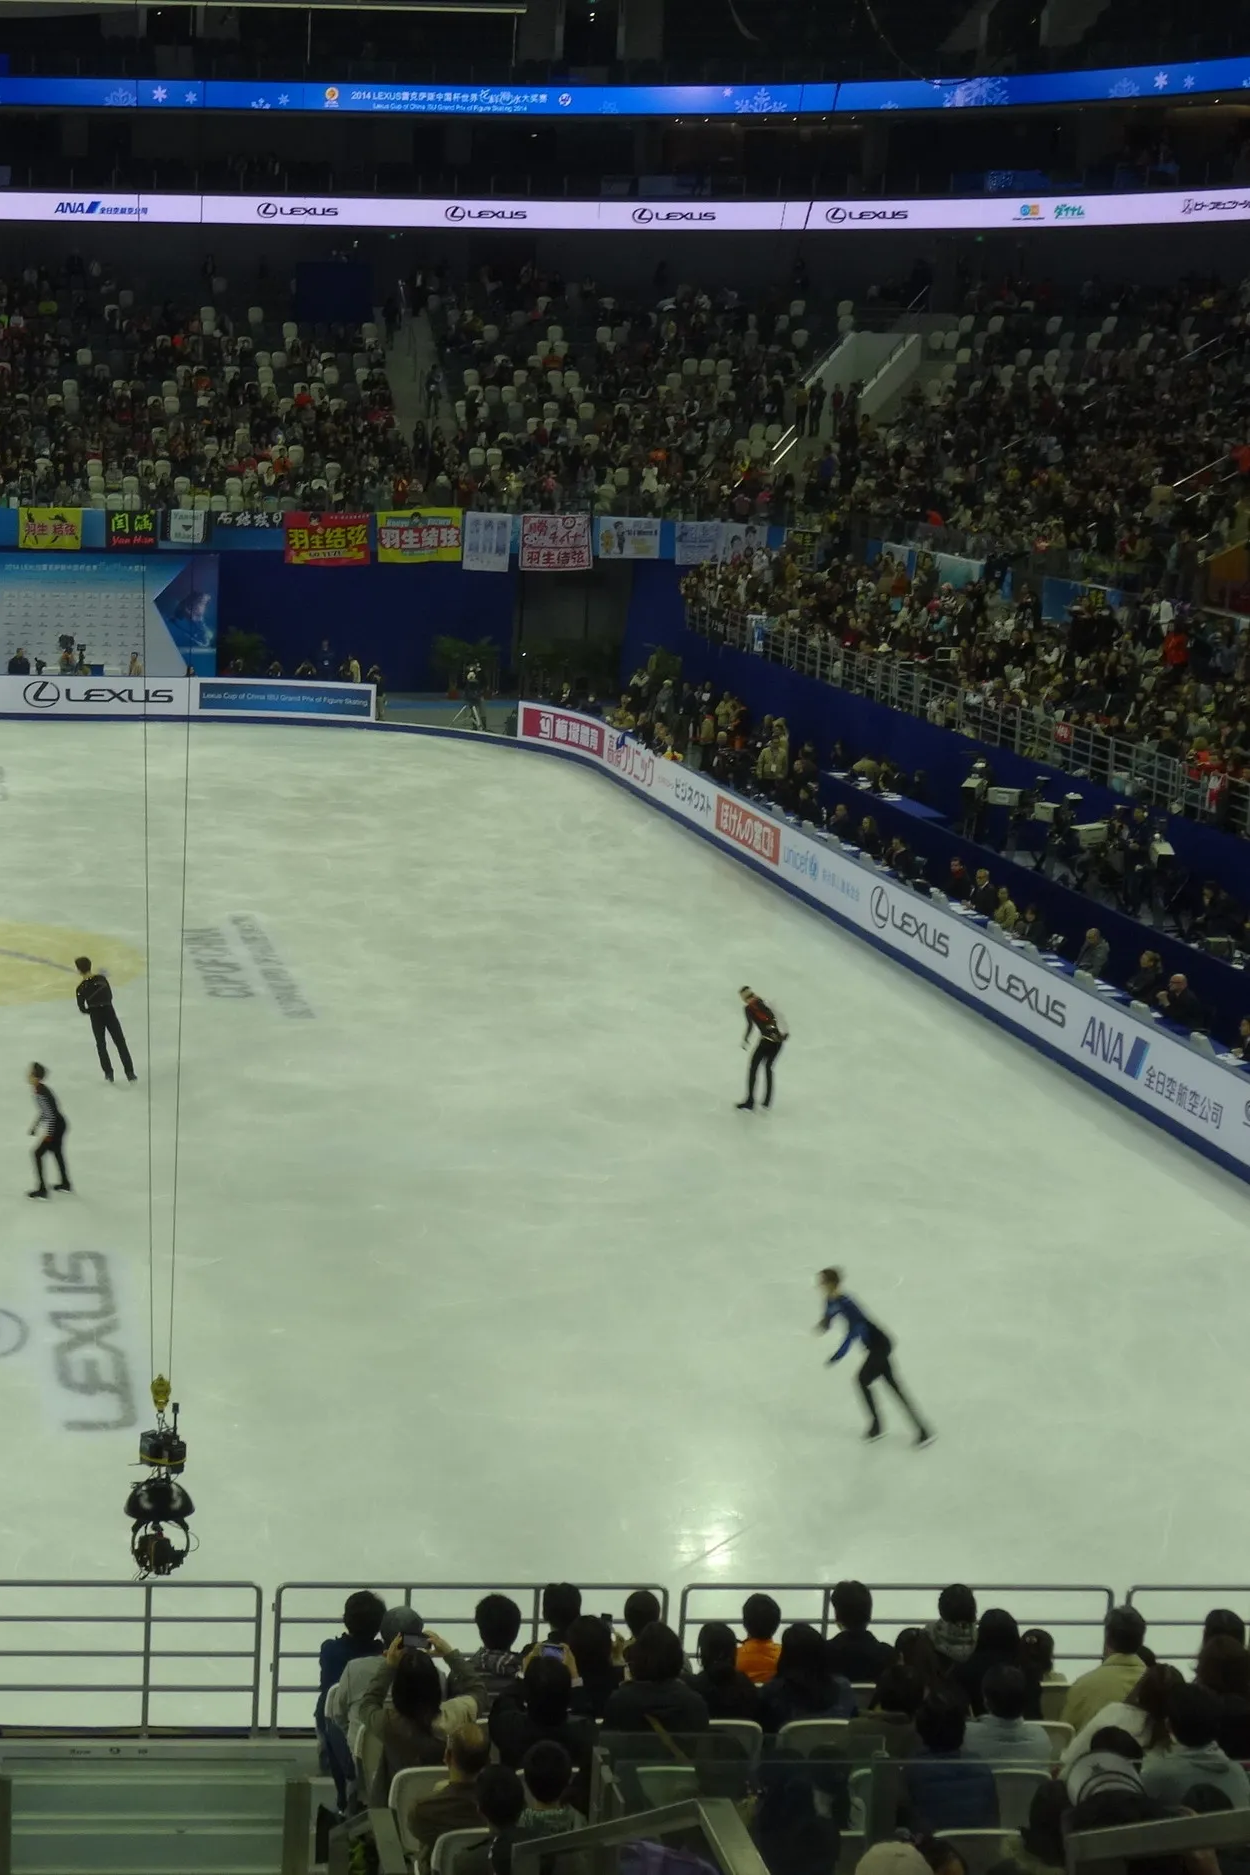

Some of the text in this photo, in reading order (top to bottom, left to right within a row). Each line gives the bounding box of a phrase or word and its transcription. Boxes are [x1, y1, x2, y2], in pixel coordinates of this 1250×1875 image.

[351, 91, 371, 100] 2014
[389, 103, 402, 111] Cup
[473, 104, 491, 112] Figure
[54, 201, 85, 214] ANA
[280, 207, 338, 216] LEXUS
[468, 209, 527, 219] LEXUS
[849, 210, 908, 220] LEXUS
[1054, 204, 1085, 219] ダイナム
[655, 211, 716, 221] LEXUS
[111, 536, 155, 546] Yan Han
[288, 524, 368, 549] 羽生结弦
[380, 527, 461, 548] 羽生结弦
[65, 688, 173, 703] LEXUS
[202, 692, 222, 700] Lexus
[223, 692, 237, 702] Cup
[247, 693, 266, 701] China
[280, 694, 301, 702] Grand
[323, 696, 344, 705] Figure
[345, 697, 368, 708] Skating
[720, 803, 769, 857] ほけんの窓口
[783, 846, 809, 875] unicef
[891, 905, 949, 958] LEXUS
[995, 965, 1066, 1028] LEXUS
[1080, 1016, 1224, 1130] ANA 全日空航空公司
[41, 1250, 137, 1431] LEXUS
